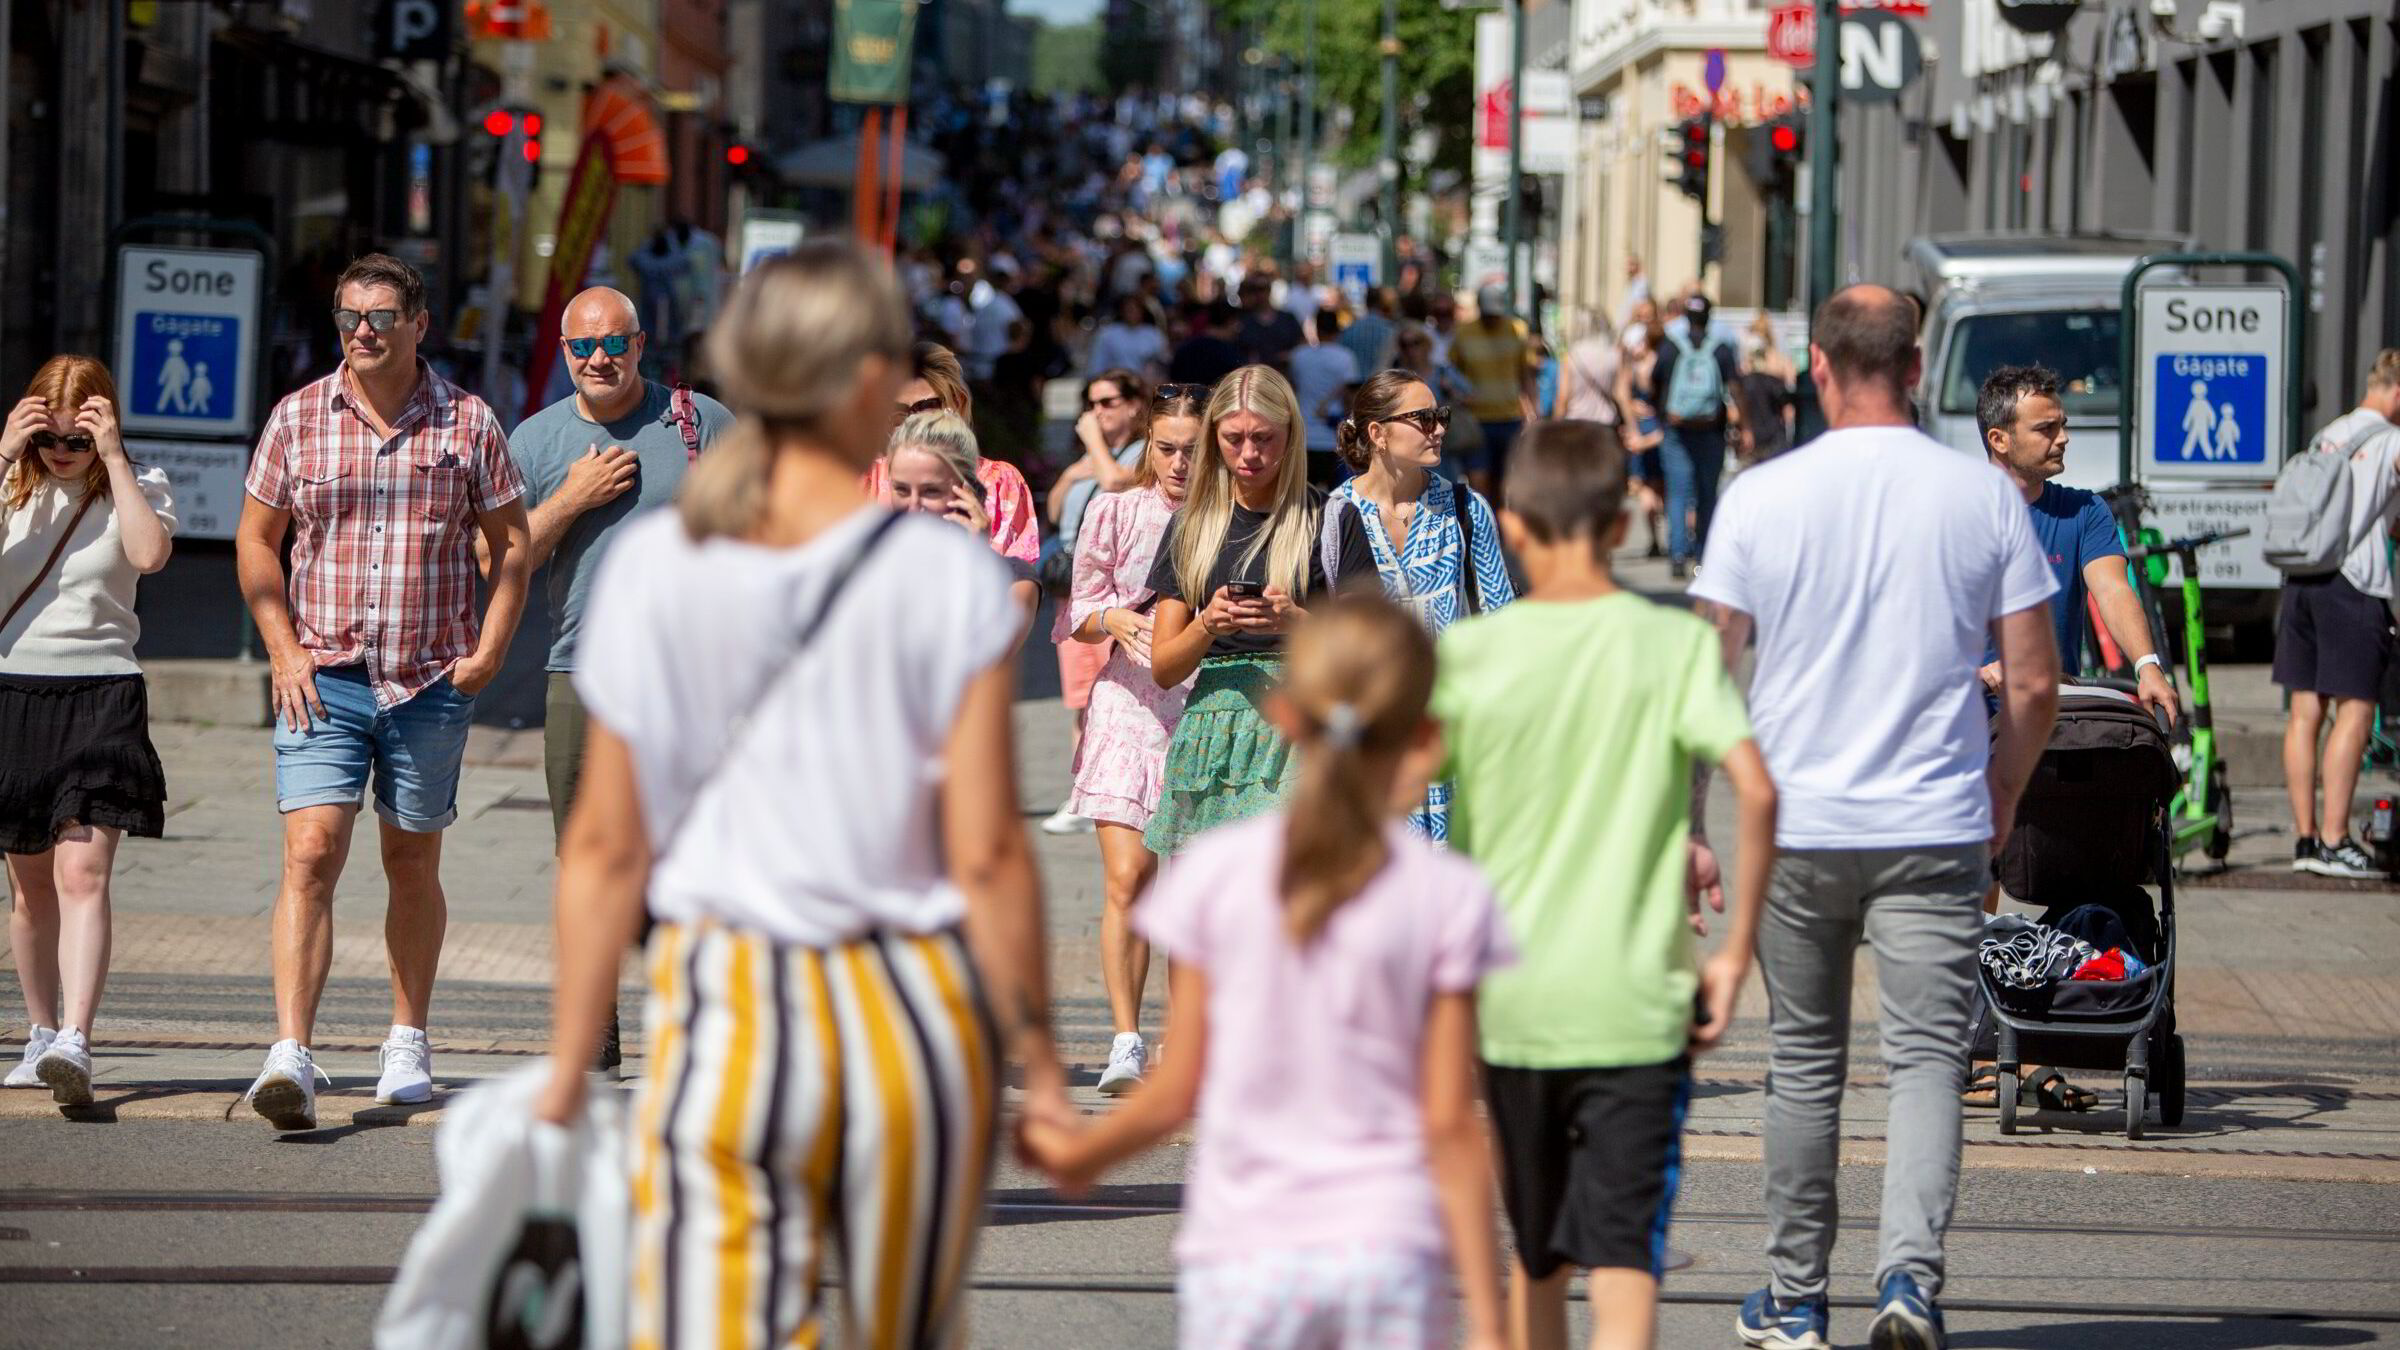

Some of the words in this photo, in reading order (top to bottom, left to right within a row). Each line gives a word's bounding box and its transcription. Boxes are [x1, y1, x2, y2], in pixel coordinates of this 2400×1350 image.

[1840, 21, 1903, 90] N
[145, 259, 236, 297] Sone
[2165, 297, 2260, 333] Sone
[2173, 353, 2249, 381] Gågate
